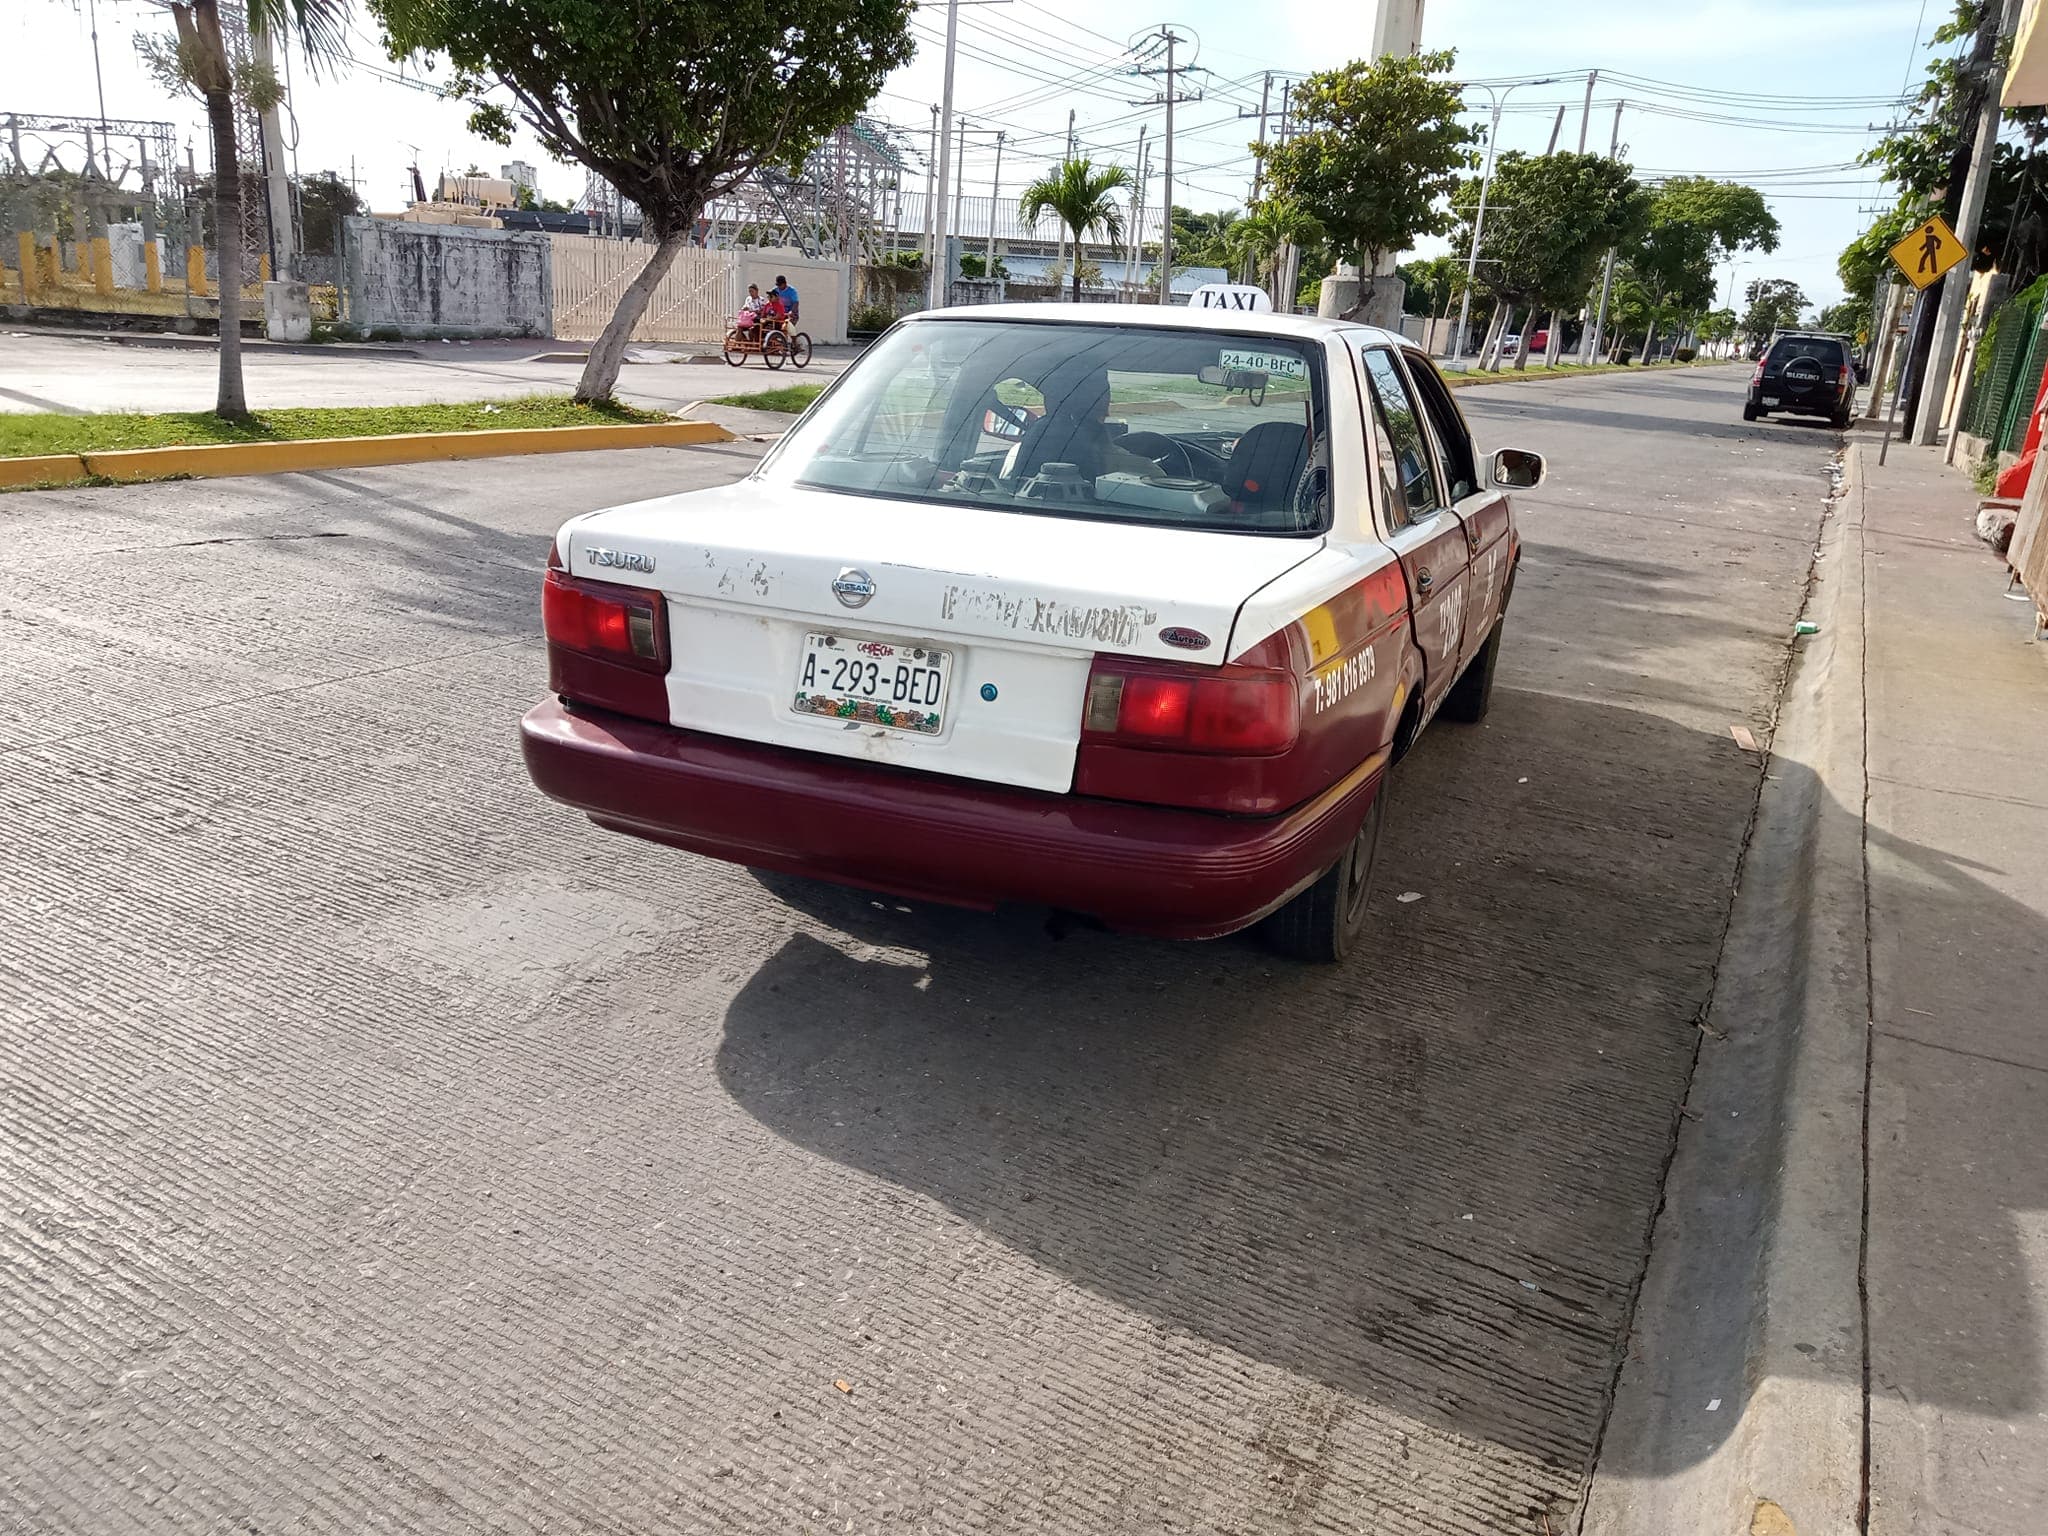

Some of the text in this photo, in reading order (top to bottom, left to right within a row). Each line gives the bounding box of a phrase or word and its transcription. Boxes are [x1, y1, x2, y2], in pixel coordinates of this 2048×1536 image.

[1200, 290, 1259, 312] TAXI
[1223, 354, 1295, 374] 24-40-BFC
[1786, 371, 1820, 381] SUZUKI
[586, 546, 657, 574] TSURU
[835, 581, 870, 593] NISSAN
[802, 653, 942, 706] A-293-BED
[1315, 644, 1376, 714] T: 981 816 8979
